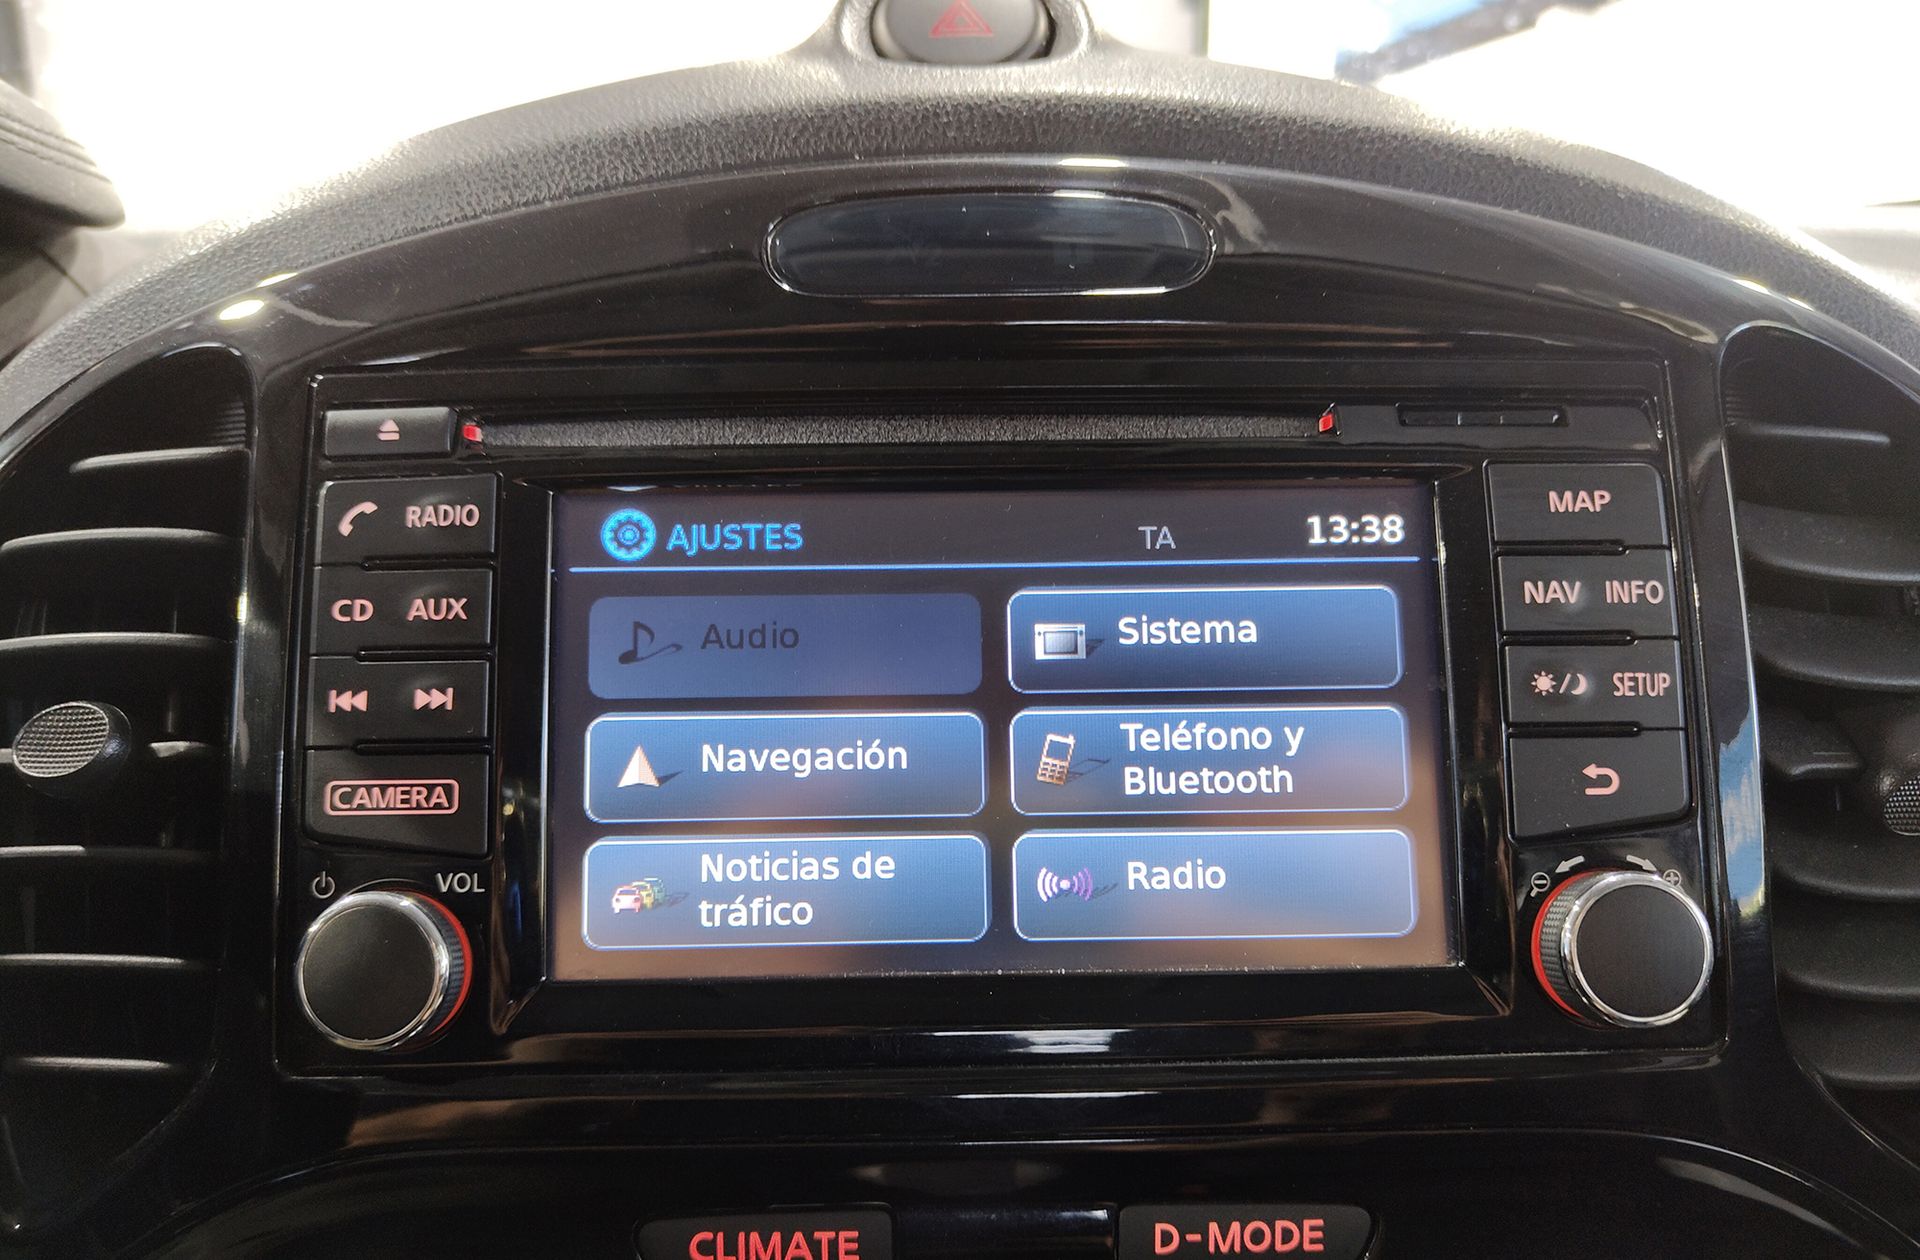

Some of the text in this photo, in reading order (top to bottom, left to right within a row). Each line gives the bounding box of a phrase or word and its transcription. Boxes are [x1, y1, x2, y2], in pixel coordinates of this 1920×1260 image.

[405, 504, 480, 529] RADIO
[1548, 490, 1612, 514] MAP
[666, 523, 804, 557] AJUSTES
[1138, 525, 1177, 550] TA
[1306, 514, 1405, 545] 13:38
[1523, 580, 1581, 605] NAV
[1605, 579, 1664, 605] INFO
[331, 599, 374, 622] CD
[406, 597, 468, 622] AUX
[700, 620, 800, 651] Audio
[1117, 614, 1259, 645] Sistema
[1612, 672, 1671, 698] SETUP
[1120, 720, 1305, 756] Teléfono y
[700, 739, 909, 778] Navegación
[1123, 765, 1294, 796] Bluetooth
[332, 786, 450, 810] CAMERA
[699, 850, 897, 883] Noticias de
[1126, 858, 1227, 891] Radio
[435, 872, 486, 894] VOL
[699, 894, 815, 928] tráfico
[688, 1230, 860, 1260] CLIMATE
[1153, 1219, 1325, 1255] D-MODE
